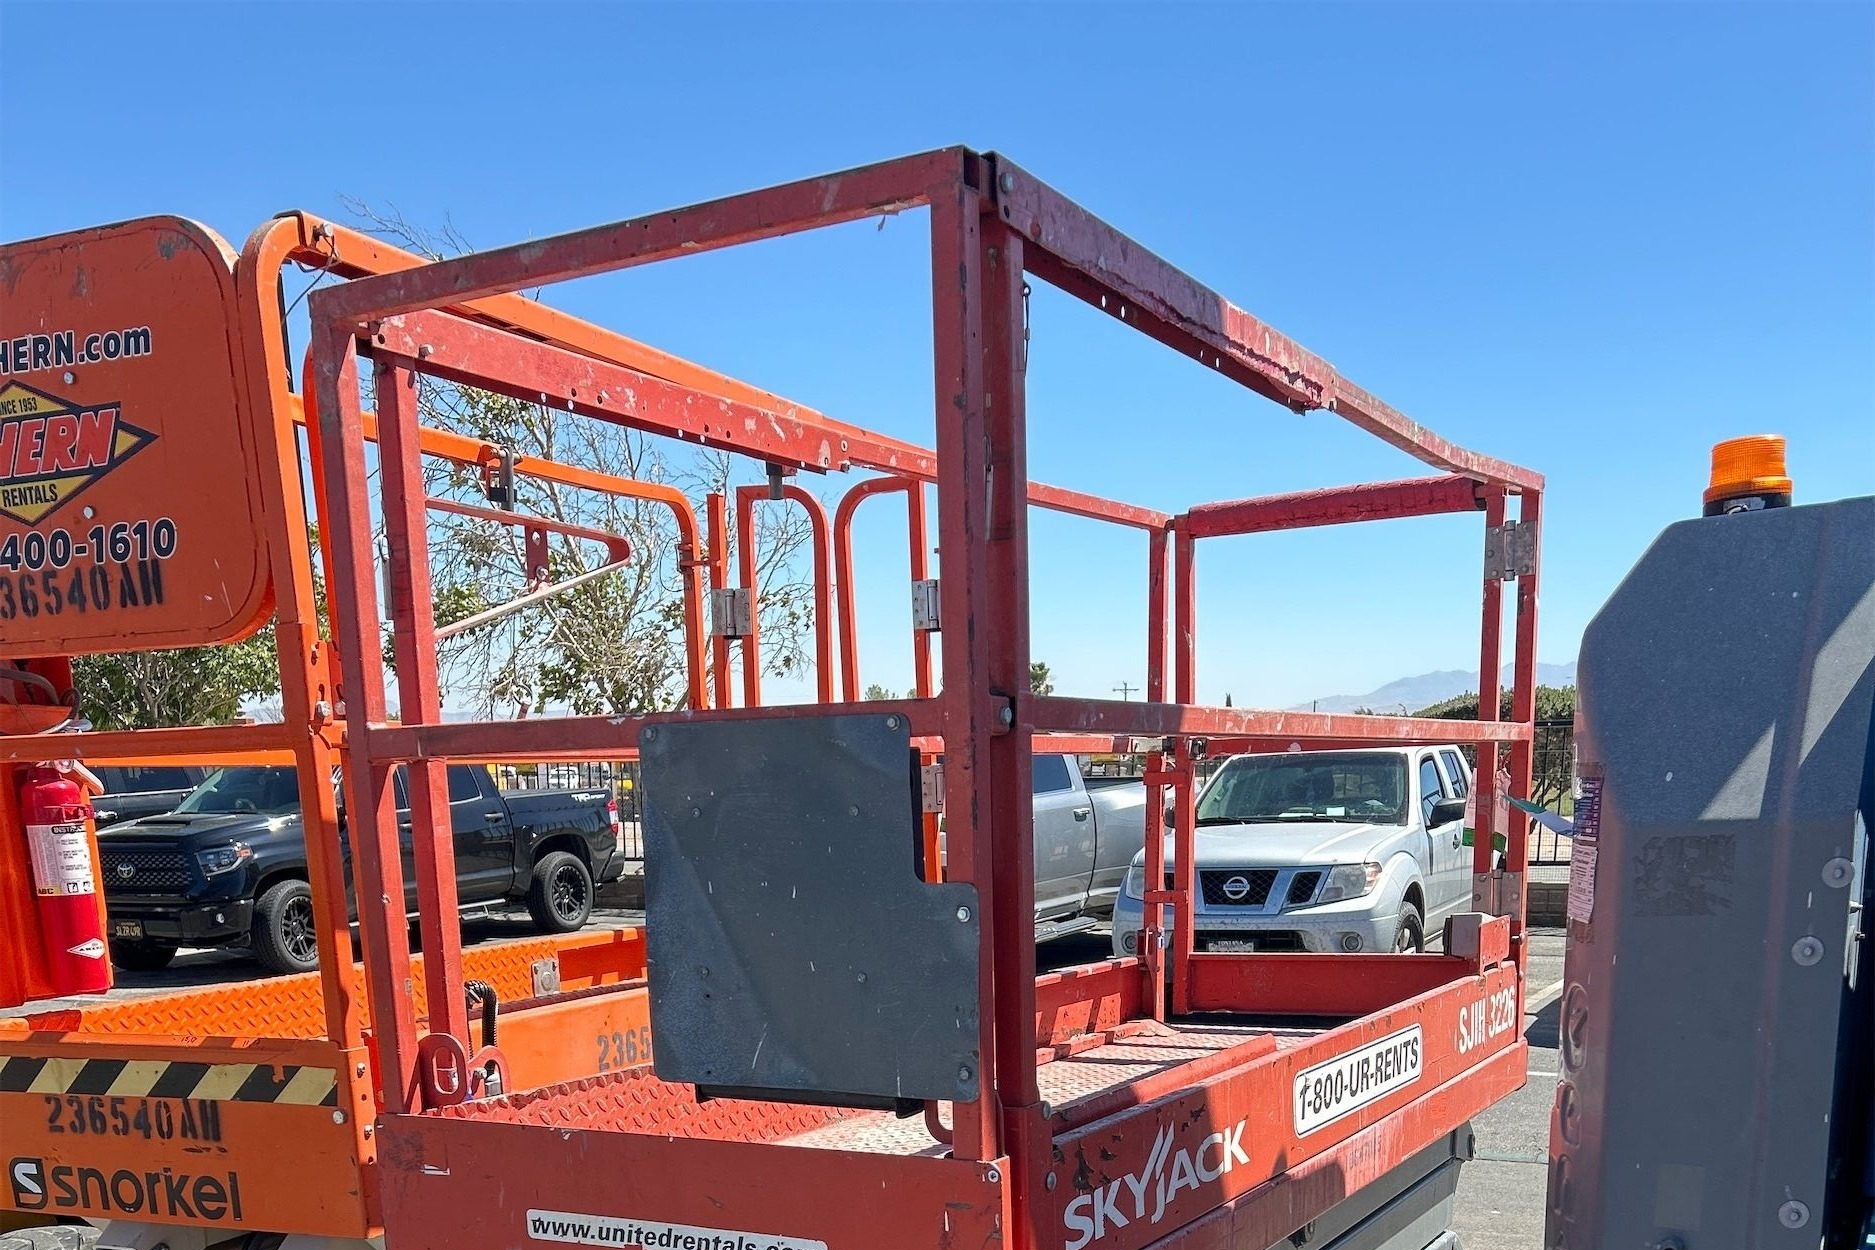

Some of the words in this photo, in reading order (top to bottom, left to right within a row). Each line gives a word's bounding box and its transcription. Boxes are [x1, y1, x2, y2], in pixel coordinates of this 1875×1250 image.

[18, 397, 38, 413] 1953
[2, 483, 58, 508] RENTALS
[0, 517, 177, 572] 400-1610
[1488, 984, 1515, 1039] 3226
[1299, 1036, 1419, 1121] 1-800-UR-RENTS
[51, 1166, 243, 1222] snorkel
